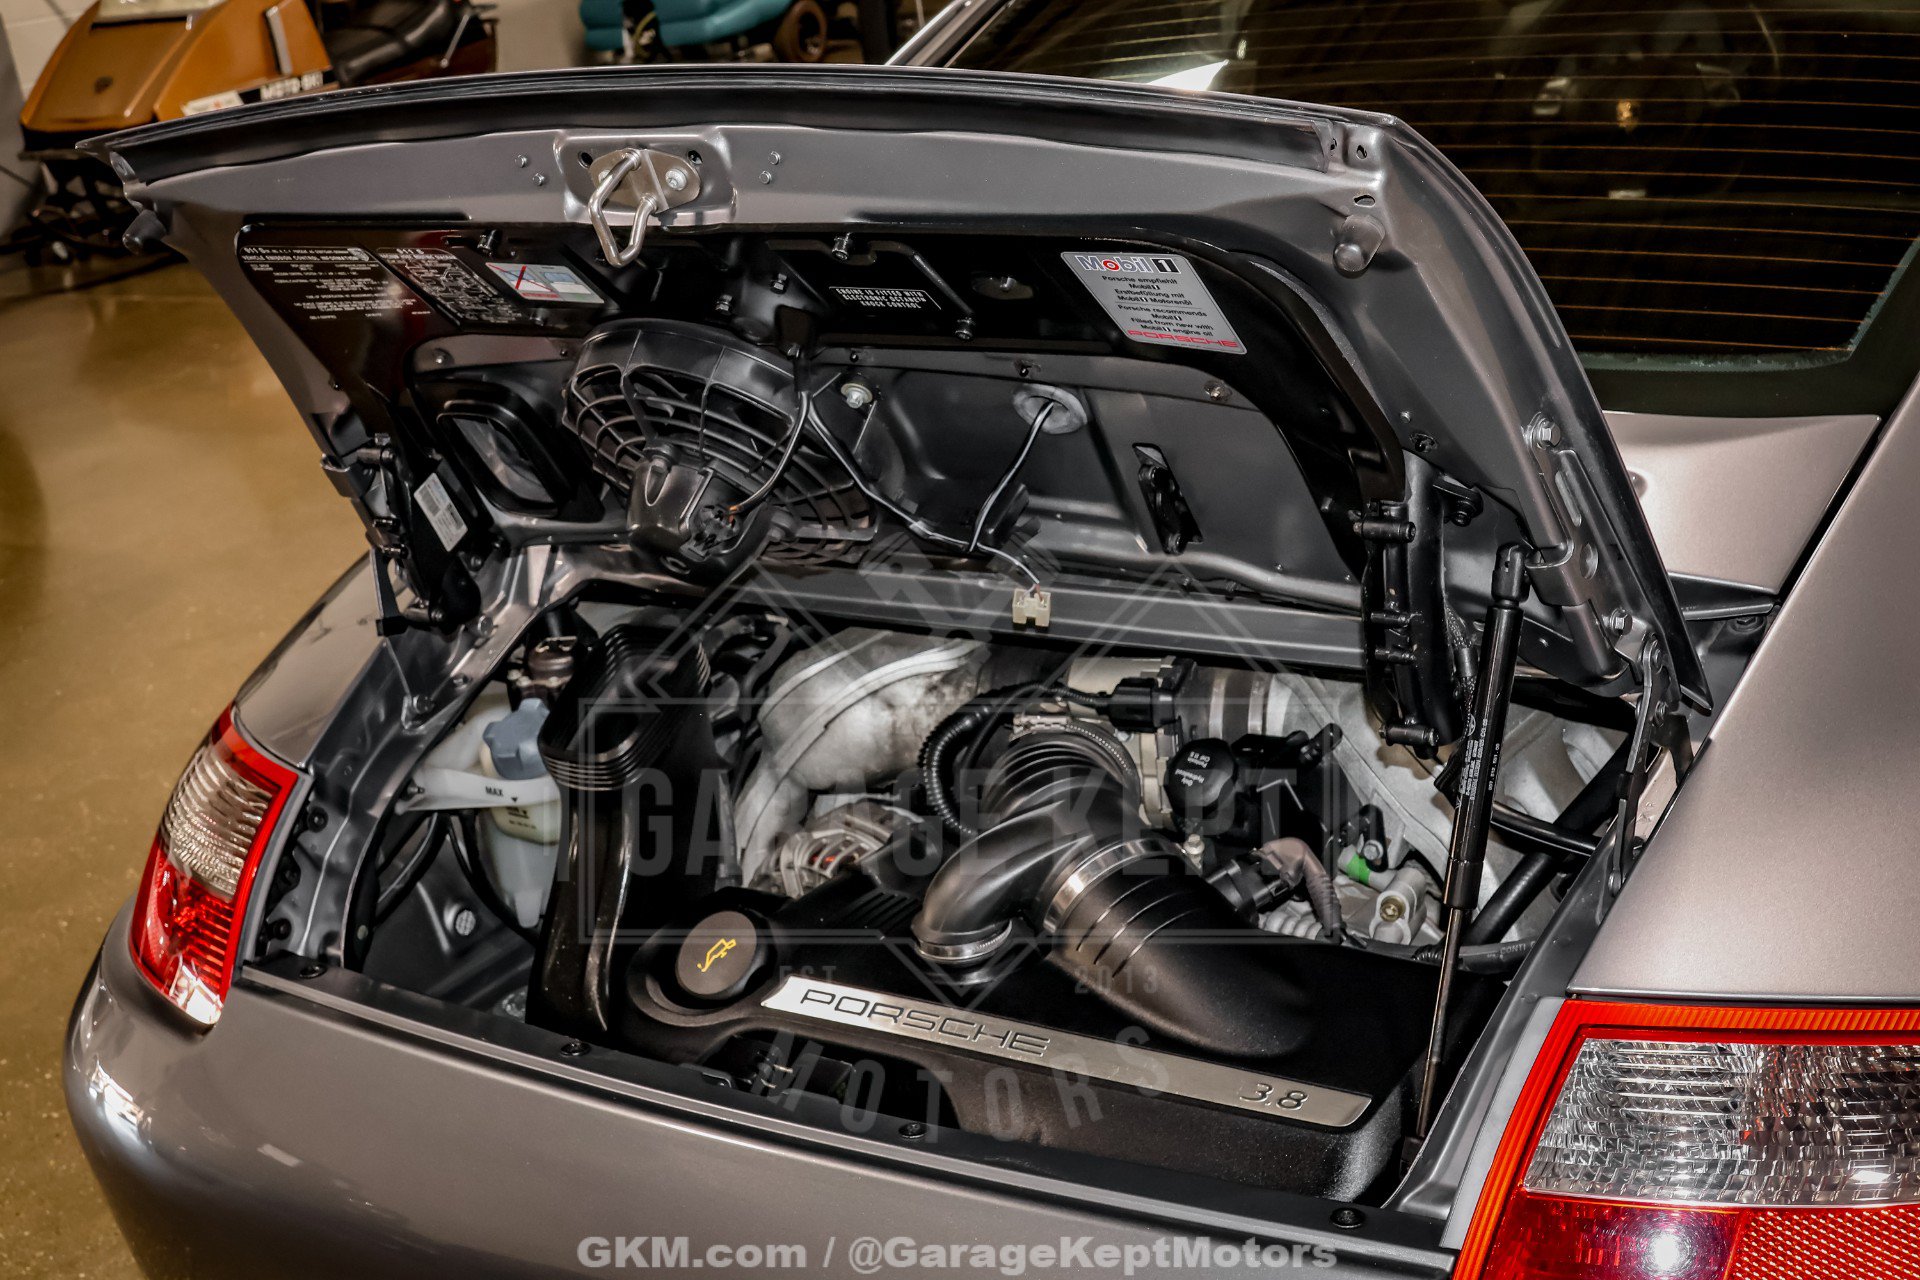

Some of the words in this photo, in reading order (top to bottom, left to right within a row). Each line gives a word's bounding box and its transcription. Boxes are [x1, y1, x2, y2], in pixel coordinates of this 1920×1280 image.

[1075, 255, 1154, 273] Mobil
[1102, 275, 1136, 284] Porsche
[886, 301, 922, 309] CONTROL
[1118, 304, 1151, 313] Porsche
[1152, 307, 1208, 318] recommends
[1154, 319, 1174, 327] from
[1194, 323, 1214, 331] with
[1172, 328, 1202, 336] engine
[1127, 330, 1239, 348] PORSCHE
[485, 786, 504, 797] MAX
[800, 988, 1051, 1058] PORSCHE
[1239, 1082, 1309, 1111] 3.8
